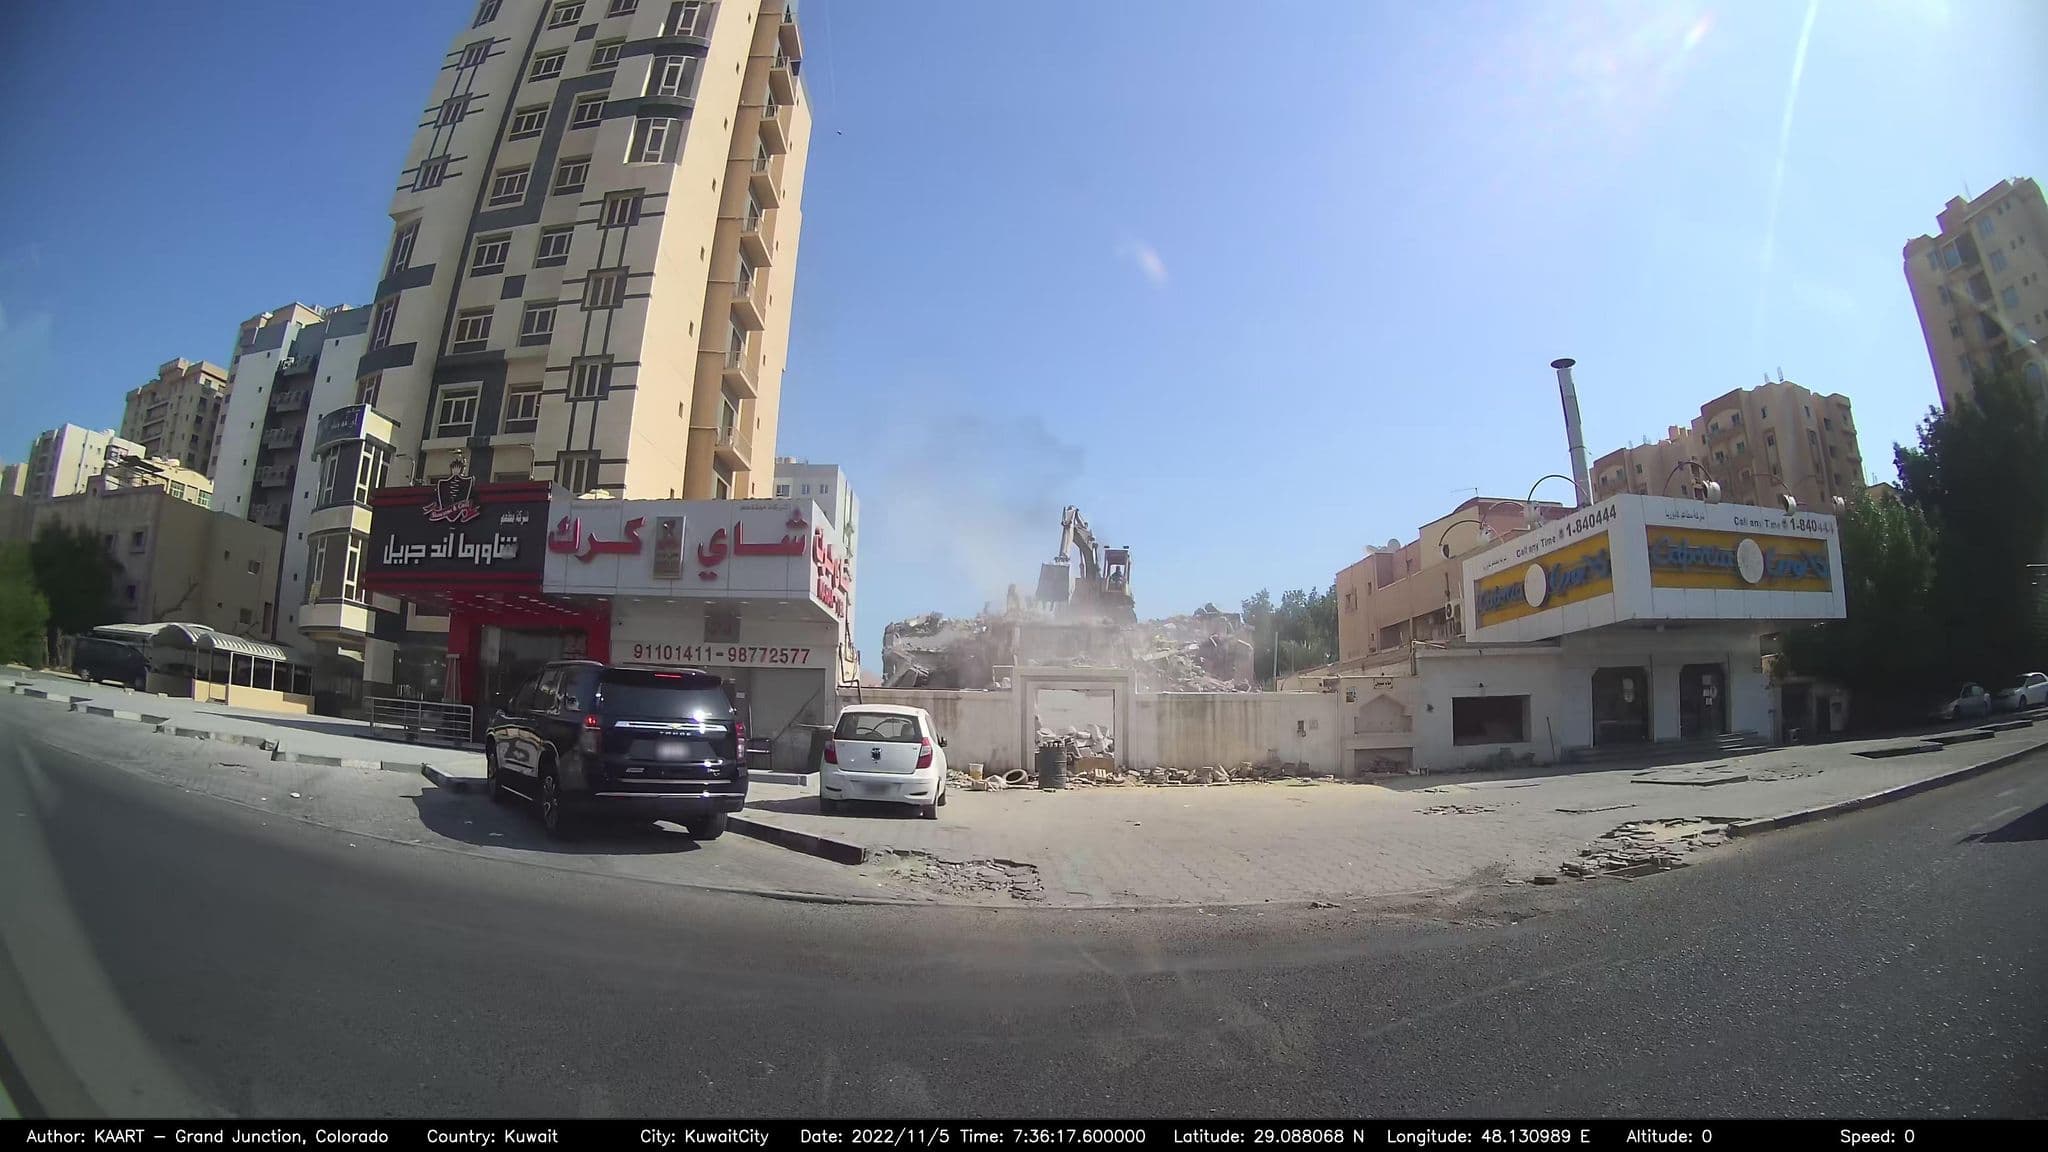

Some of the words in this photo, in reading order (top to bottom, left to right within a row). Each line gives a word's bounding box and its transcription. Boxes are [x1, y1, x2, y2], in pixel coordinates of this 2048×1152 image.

[383, 533, 426, 565] جريل
[458, 532, 518, 565] شاورما
[548, 514, 647, 563] كرك
[698, 505, 809, 581] شاي
